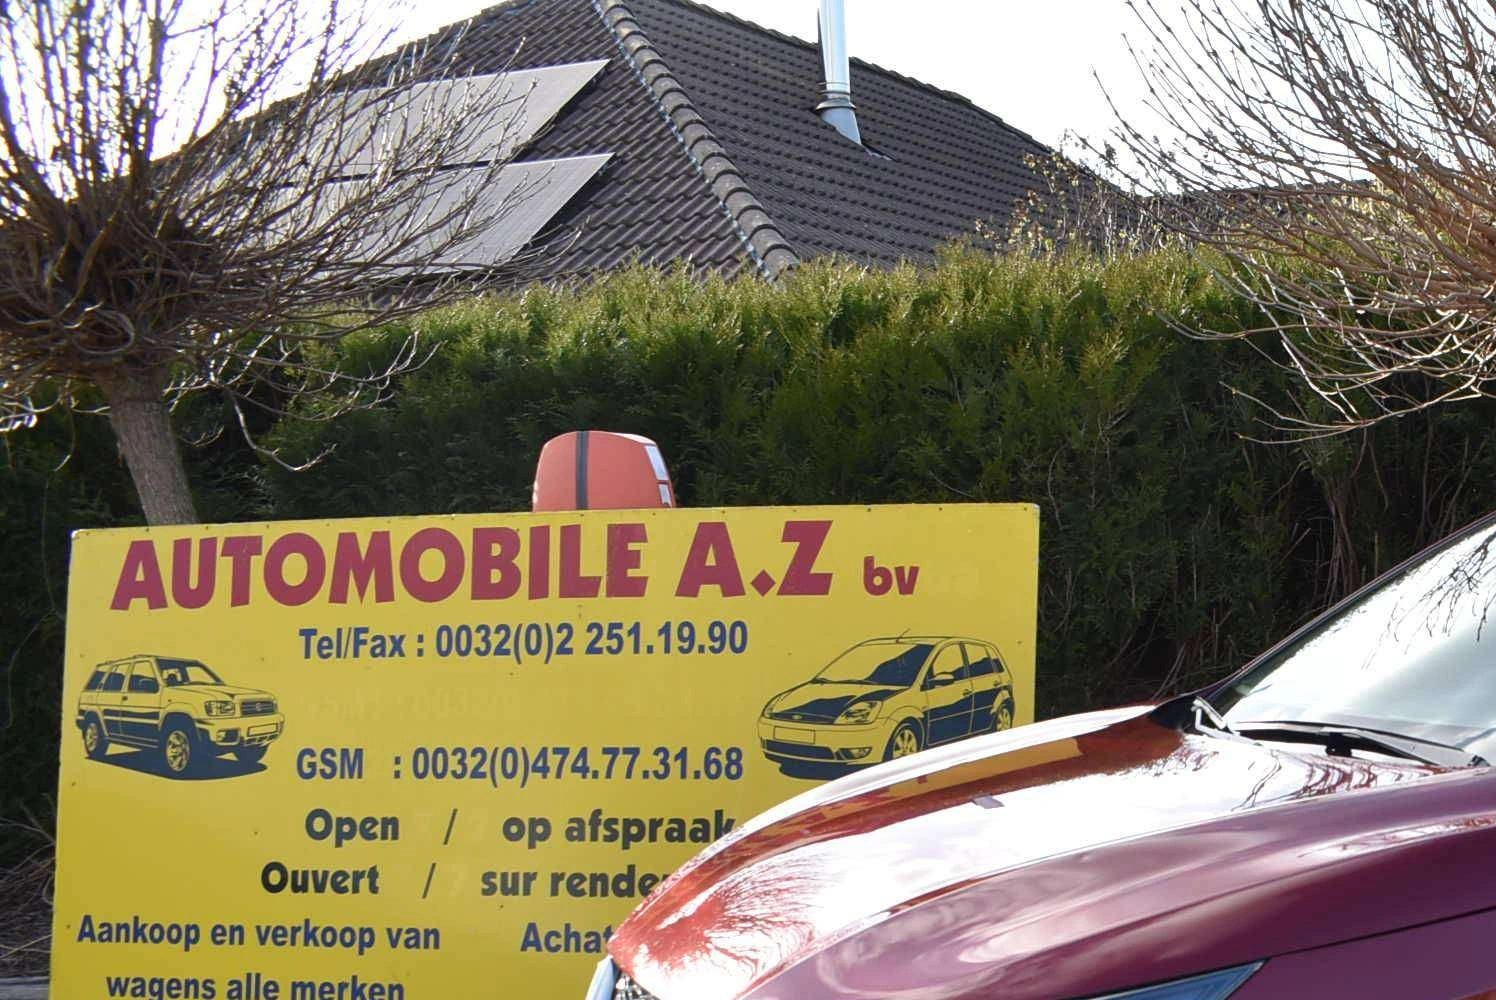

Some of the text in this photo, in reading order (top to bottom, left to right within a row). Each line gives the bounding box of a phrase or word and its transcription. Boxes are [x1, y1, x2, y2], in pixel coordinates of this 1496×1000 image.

[110, 520, 920, 611] AUTOMOBILE A.Z bv
[299, 627, 406, 660] Tel/Fax
[435, 622, 574, 665] 0032(0)2
[585, 620, 749, 656] 251.19.90
[296, 747, 364, 780] GSM
[412, 746, 743, 788] 0032(0)474.77.31.68
[305, 808, 399, 848] Open
[502, 816, 552, 849] op
[261, 861, 379, 894] Ouvert
[481, 870, 538, 897] sur
[550, 864, 671, 898] rende
[77, 915, 440, 956] Aankoop en verkoop van
[227, 973, 280, 1000] alle
